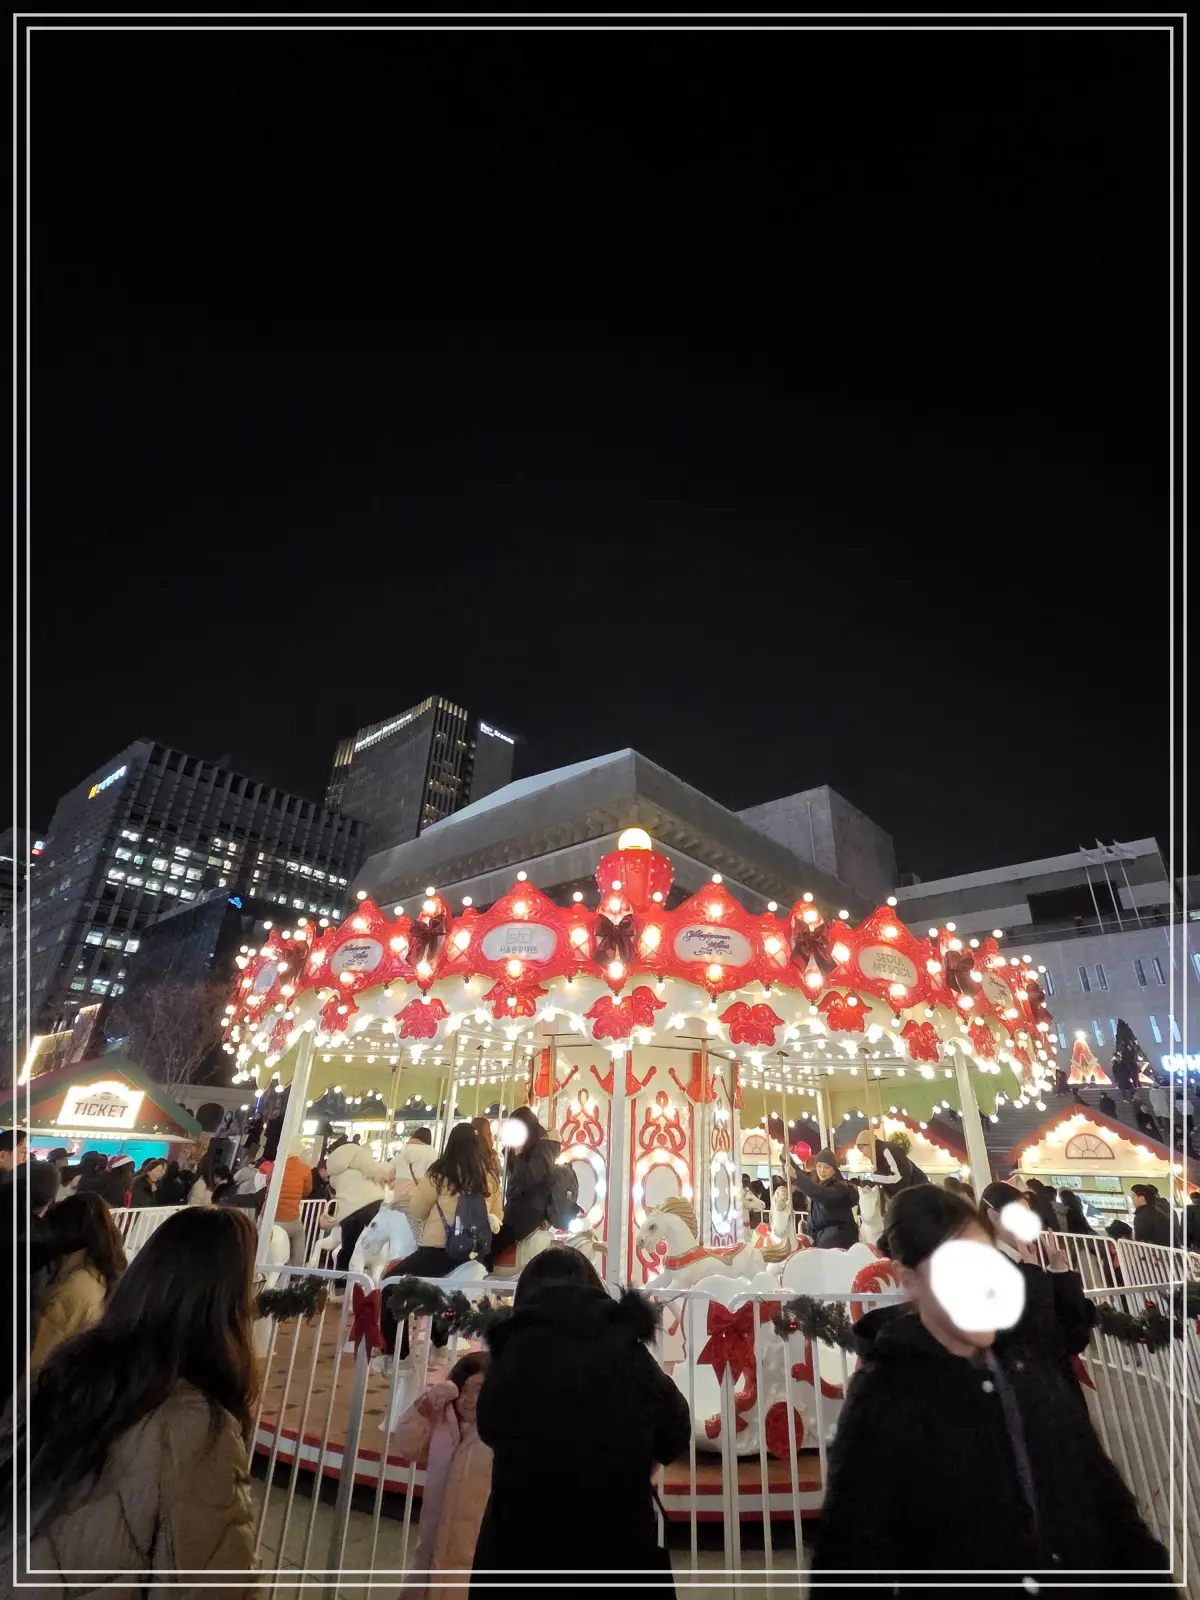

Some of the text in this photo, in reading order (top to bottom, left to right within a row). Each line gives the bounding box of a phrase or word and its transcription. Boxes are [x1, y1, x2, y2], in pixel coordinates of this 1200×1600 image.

[876, 952, 905, 967] SEOUL
[887, 964, 912, 978] SOUL
[74, 1102, 129, 1118] TICKET
